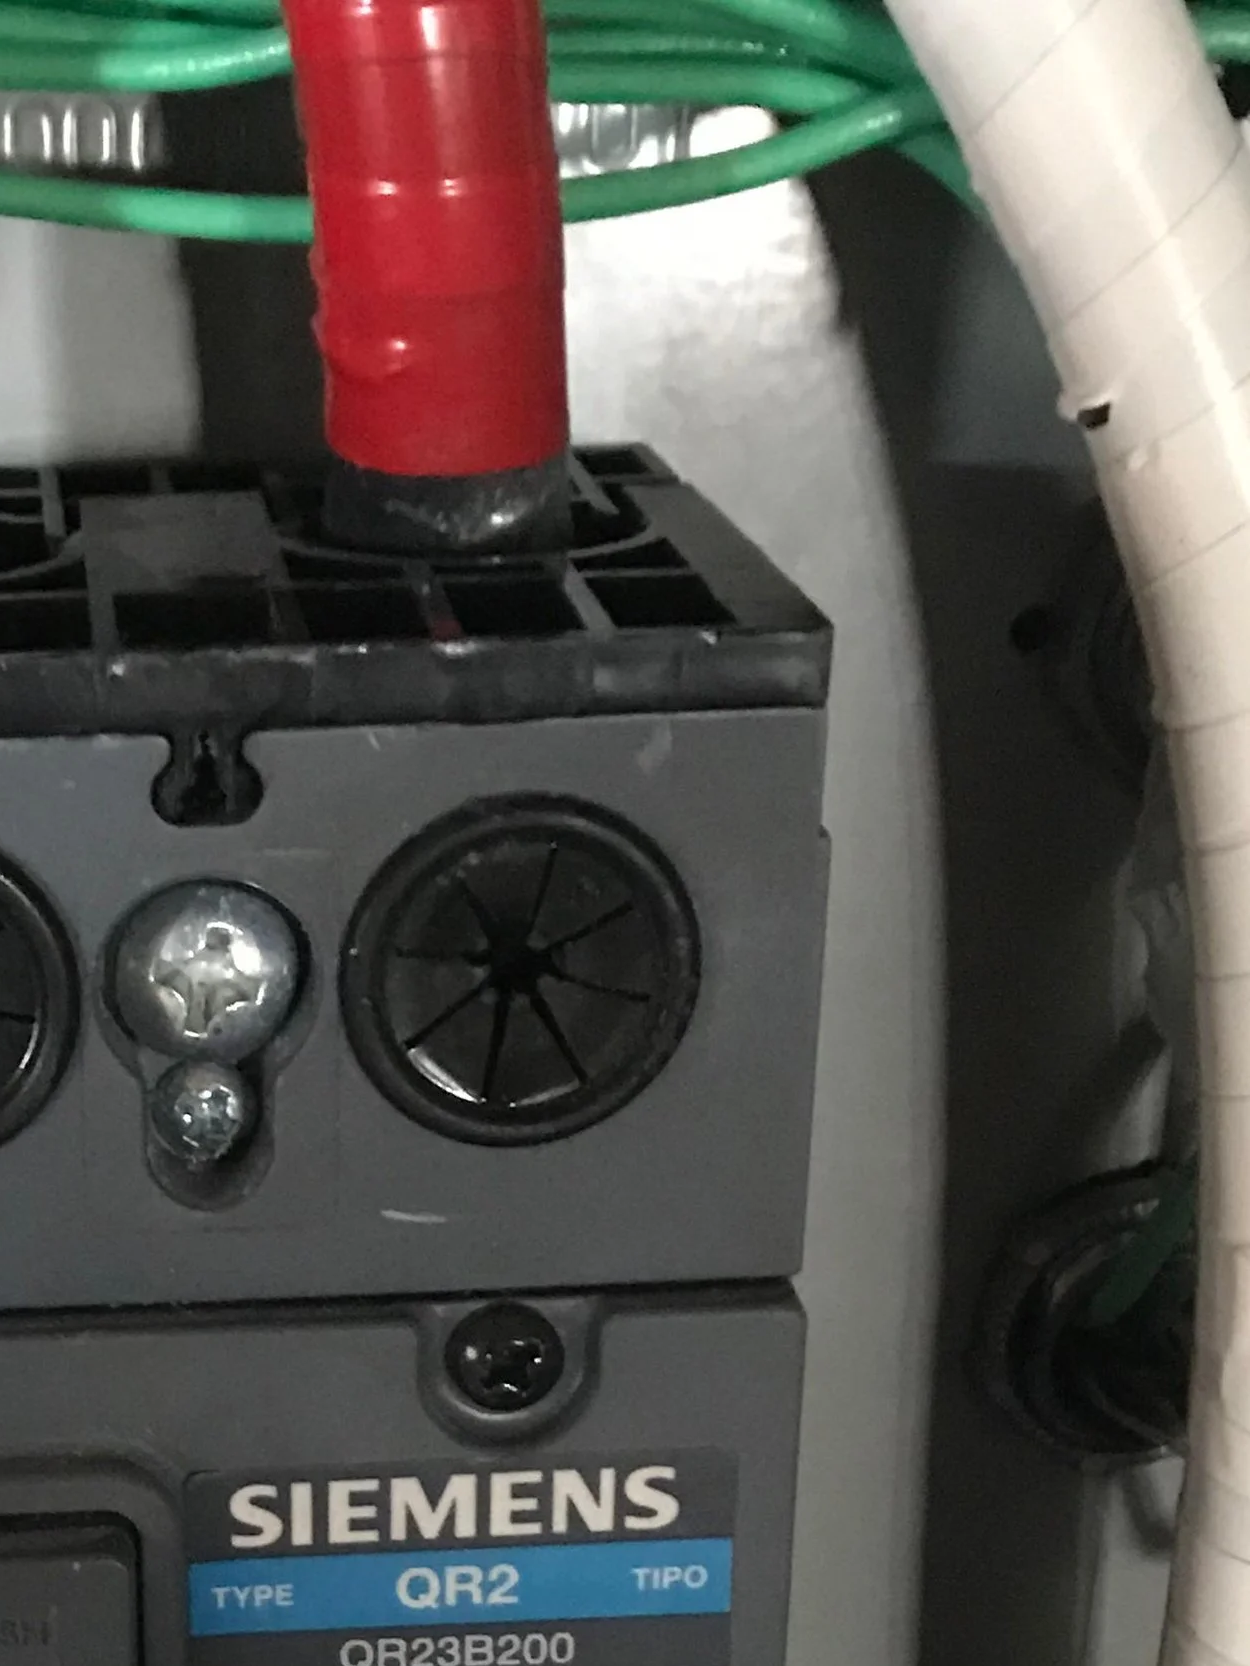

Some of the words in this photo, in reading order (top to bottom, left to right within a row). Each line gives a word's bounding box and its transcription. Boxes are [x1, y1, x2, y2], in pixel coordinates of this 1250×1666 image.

[229, 1465, 680, 1549] SIEMENS
[212, 1584, 294, 1609] TYPE
[395, 1564, 521, 1610] QR2
[632, 1565, 708, 1590] TIPO
